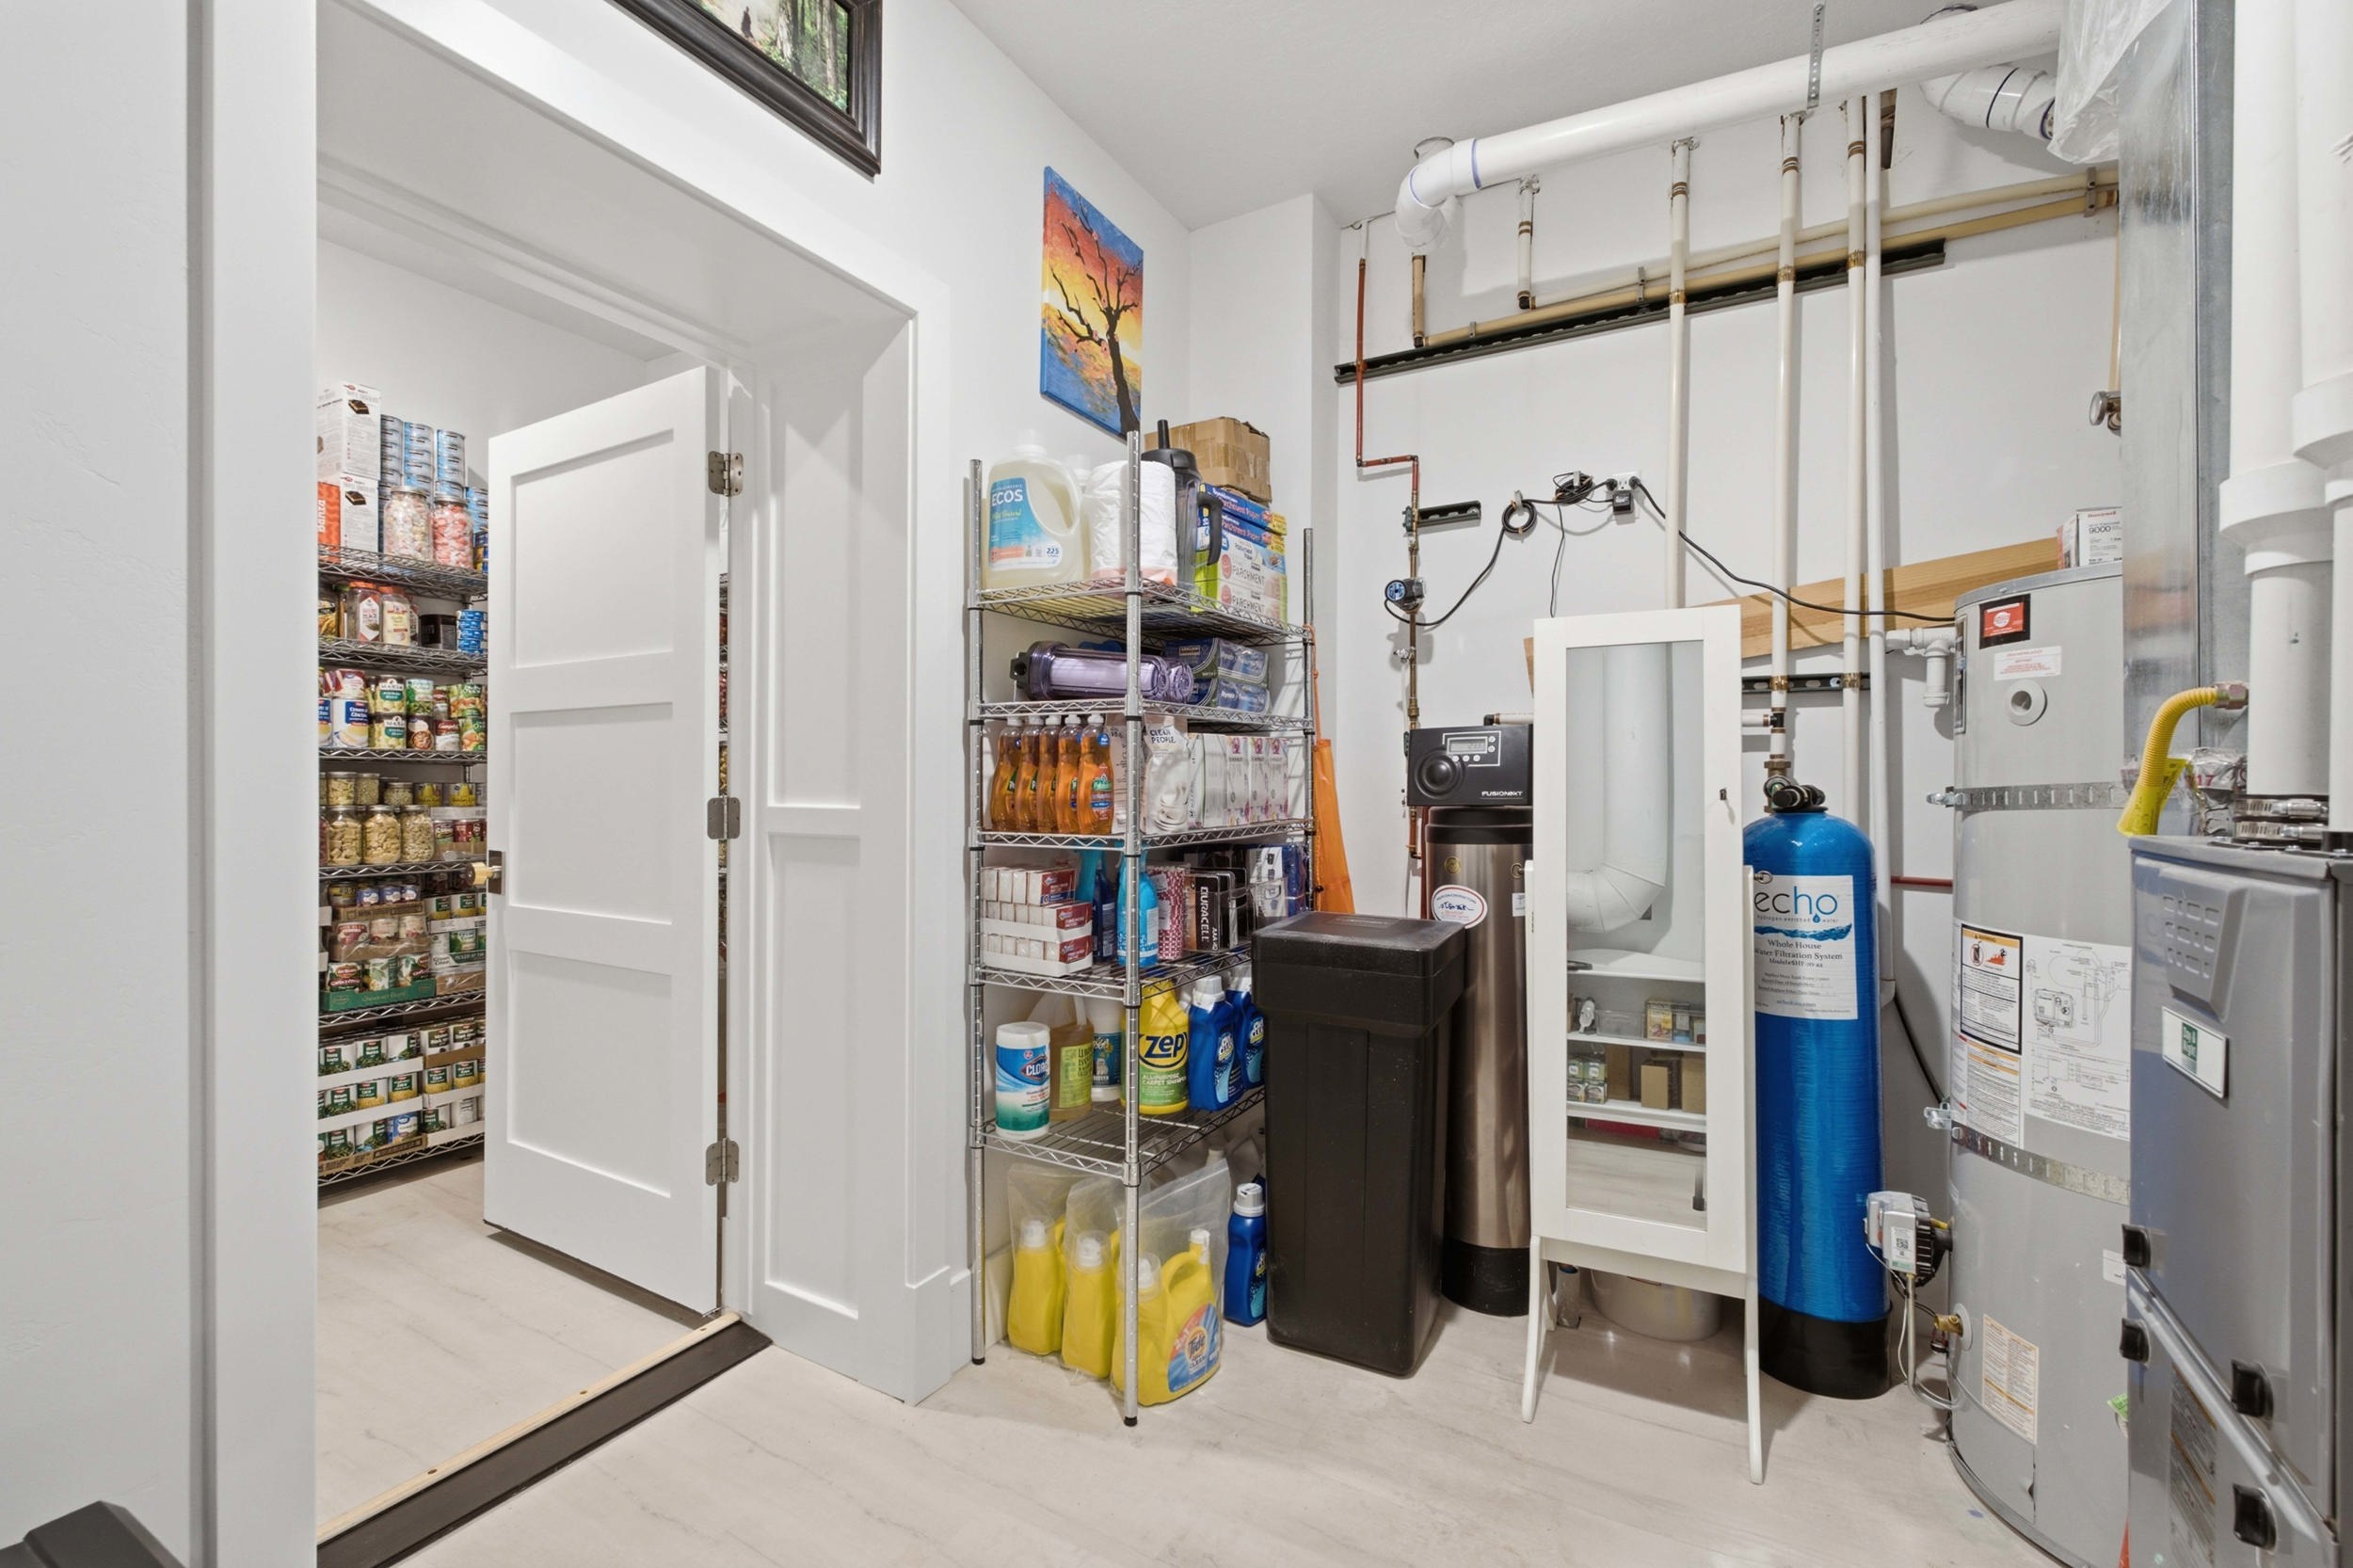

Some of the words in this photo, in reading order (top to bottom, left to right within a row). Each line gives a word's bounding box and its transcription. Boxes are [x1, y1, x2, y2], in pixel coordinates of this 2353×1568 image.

[991, 489, 1024, 506] ECOS
[1754, 886, 1838, 915] echo
[1200, 887, 1209, 942] DURACELL
[1768, 939, 1793, 949] Whole
[1815, 952, 1843, 961] System
[1144, 1032, 1185, 1058] zep
[1189, 1334, 1206, 1359] Tide
